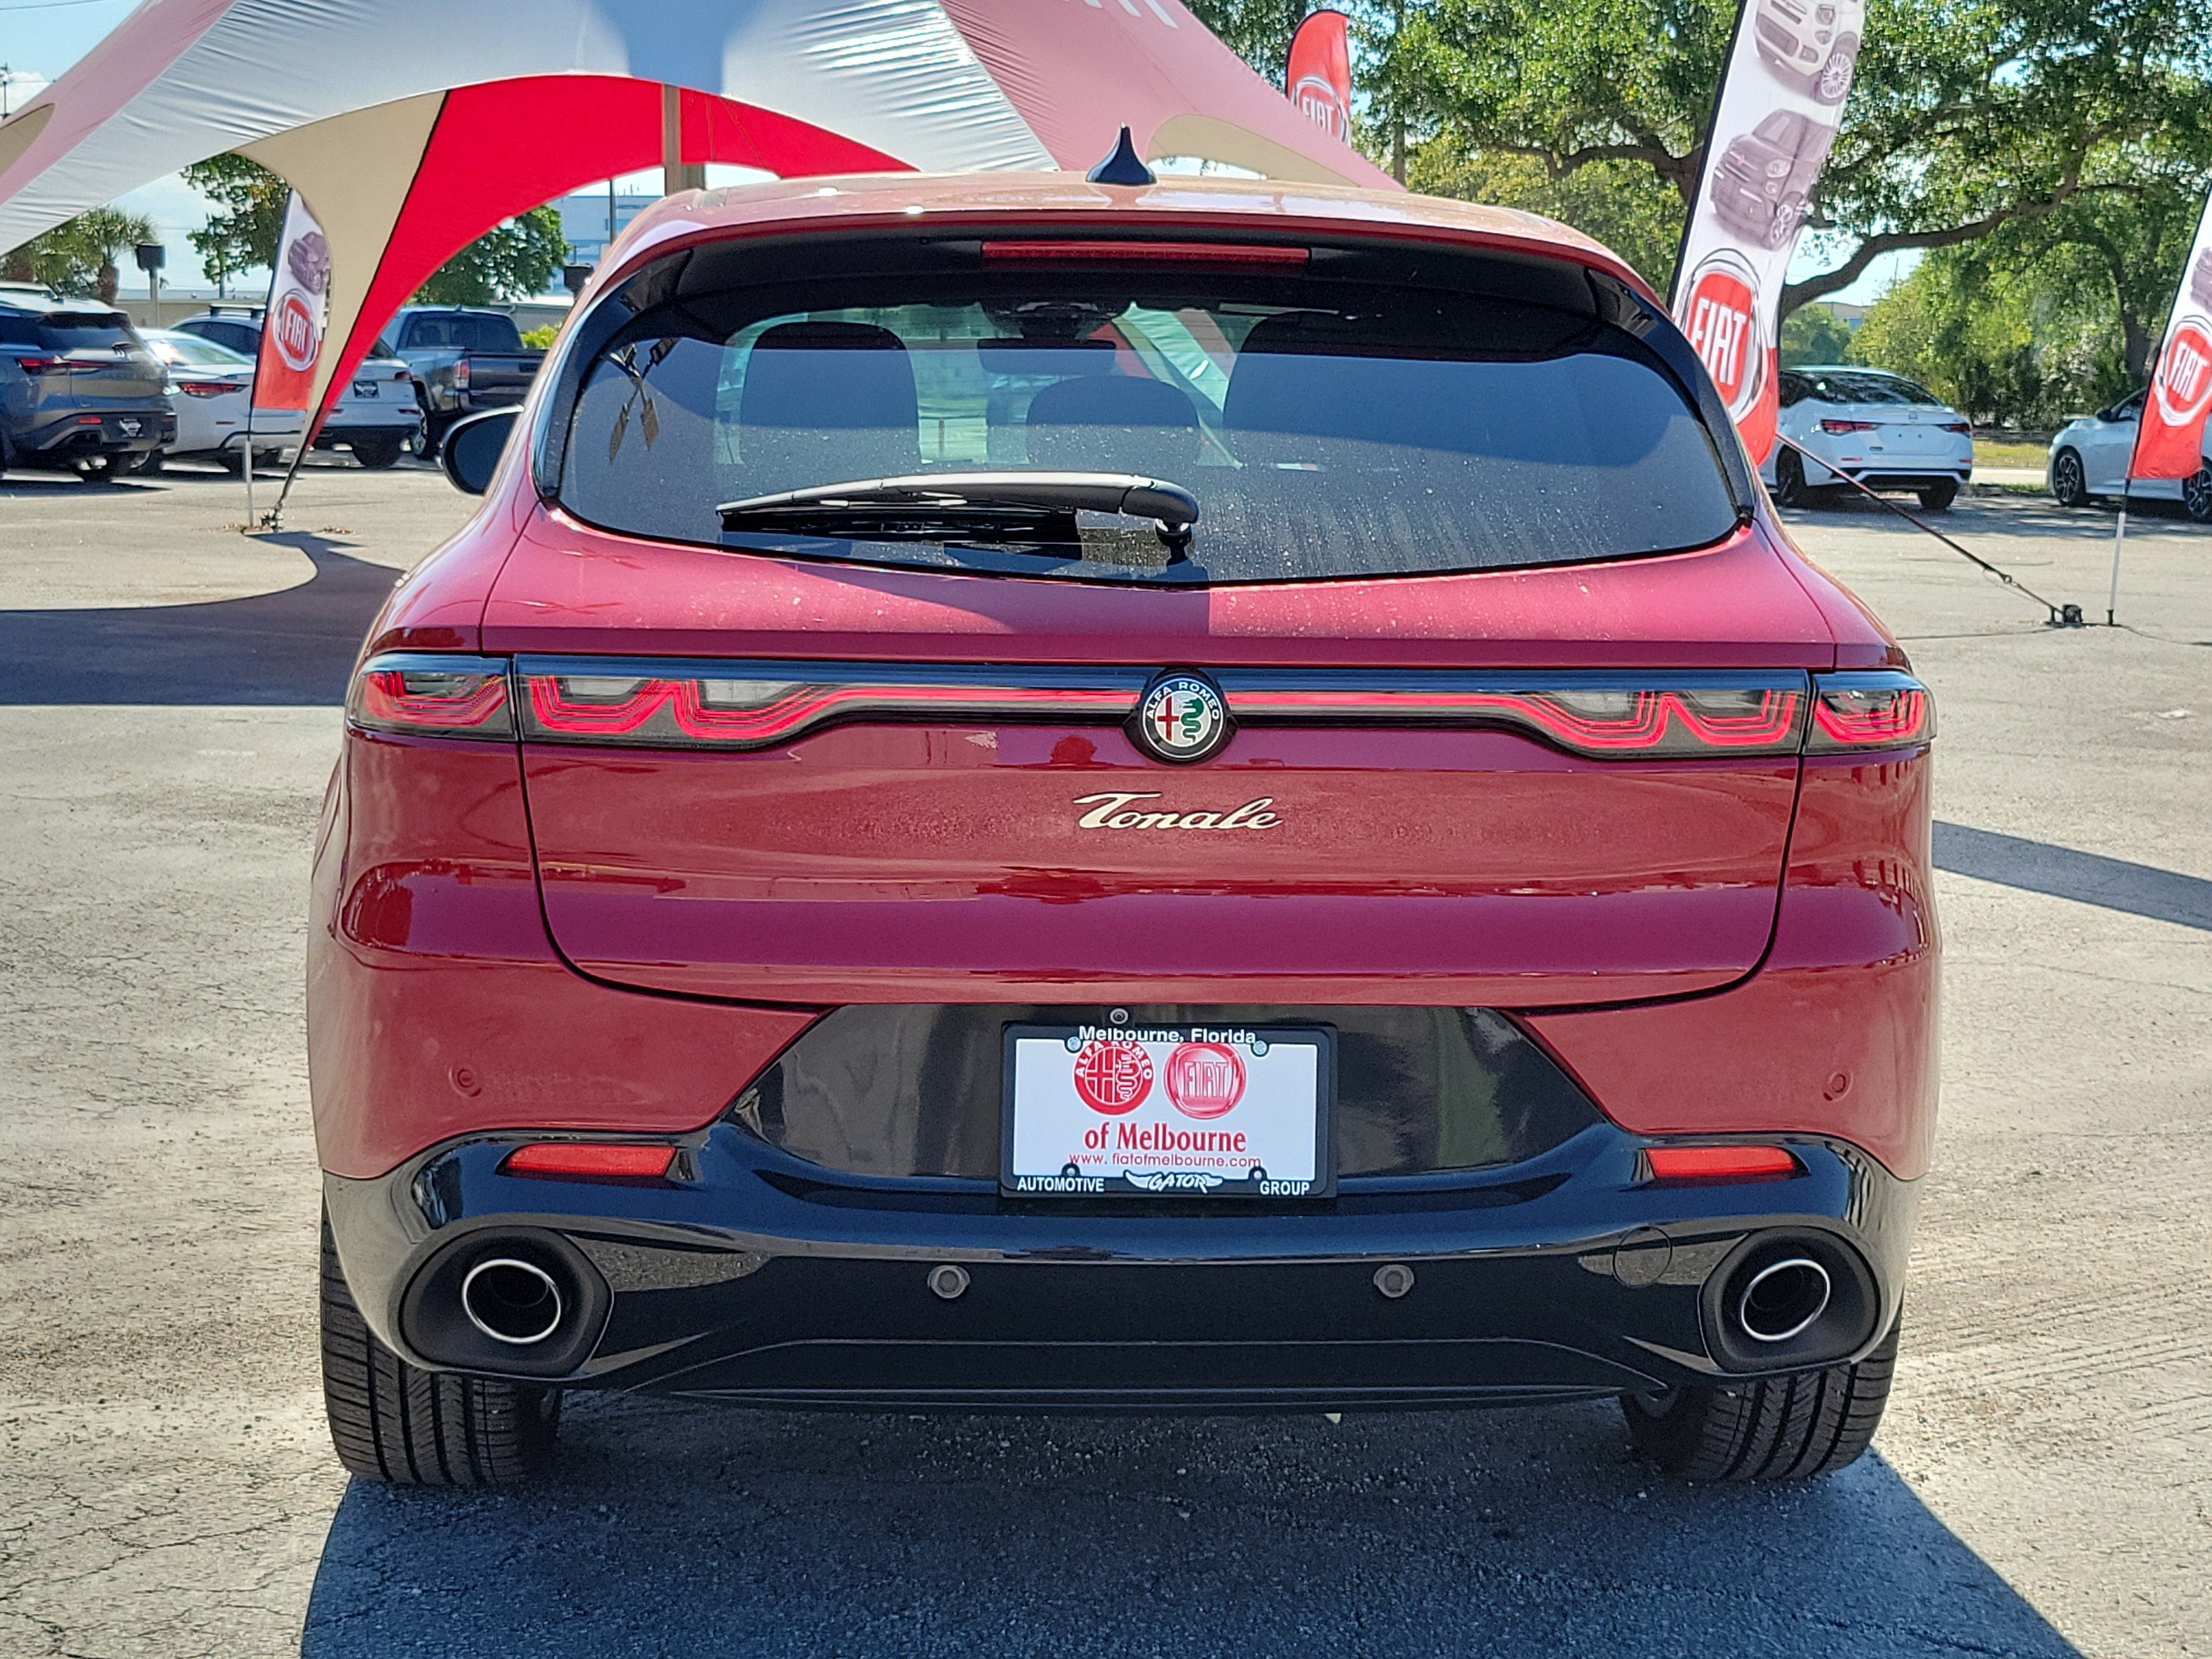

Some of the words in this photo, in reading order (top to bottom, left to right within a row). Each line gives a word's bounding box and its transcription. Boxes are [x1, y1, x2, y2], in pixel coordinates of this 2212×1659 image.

[1302, 96, 1334, 135] FIAT
[285, 308, 308, 352] FIAT
[1690, 296, 1747, 386] FIAT
[2168, 341, 2210, 403] FIAT
[1147, 686, 1172, 719] ALFA
[1178, 682, 1220, 720] ROMEO
[1073, 793, 1284, 829] Tonale
[1079, 1025, 1184, 1043] Melbourne,
[1191, 1028, 1256, 1043] Florida
[1075, 1041, 1104, 1077] ALFA
[1183, 1061, 1228, 1098] FIAT
[1084, 1122, 1110, 1149] of
[1116, 1122, 1246, 1153] Melbourne
[1017, 1177, 1105, 1192] AUTOMOTIVE
[1149, 1173, 1208, 1194] GATOR
[1260, 1181, 1310, 1195] GROUP
